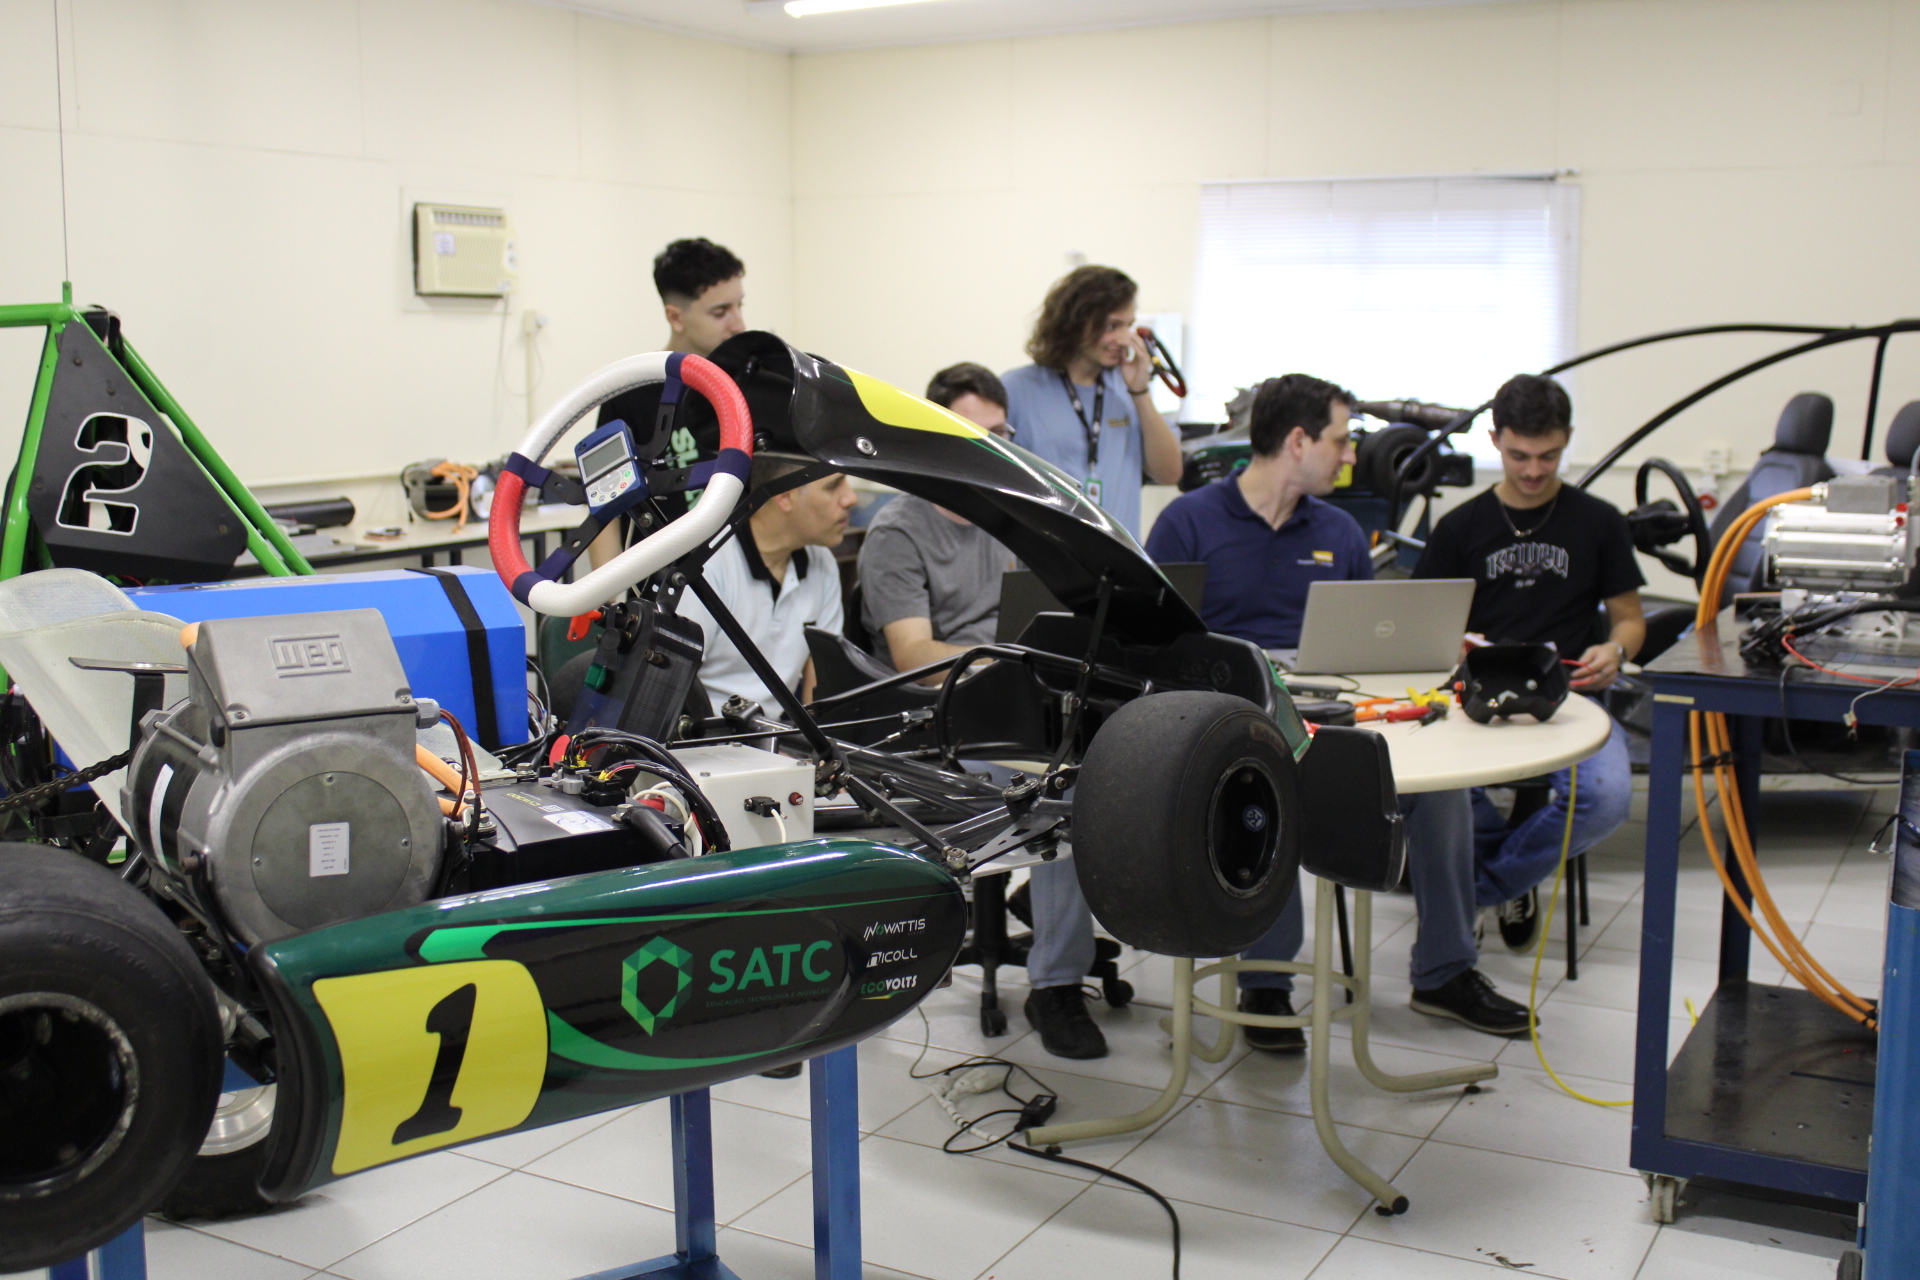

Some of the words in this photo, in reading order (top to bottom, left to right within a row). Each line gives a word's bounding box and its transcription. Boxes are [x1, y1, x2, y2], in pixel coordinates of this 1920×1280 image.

[56, 412, 154, 536] 2
[863, 918, 926, 942] INOWATTIS
[707, 940, 833, 994] SATC
[861, 975, 918, 994] ECOVOLTS
[392, 982, 477, 1146] 1
